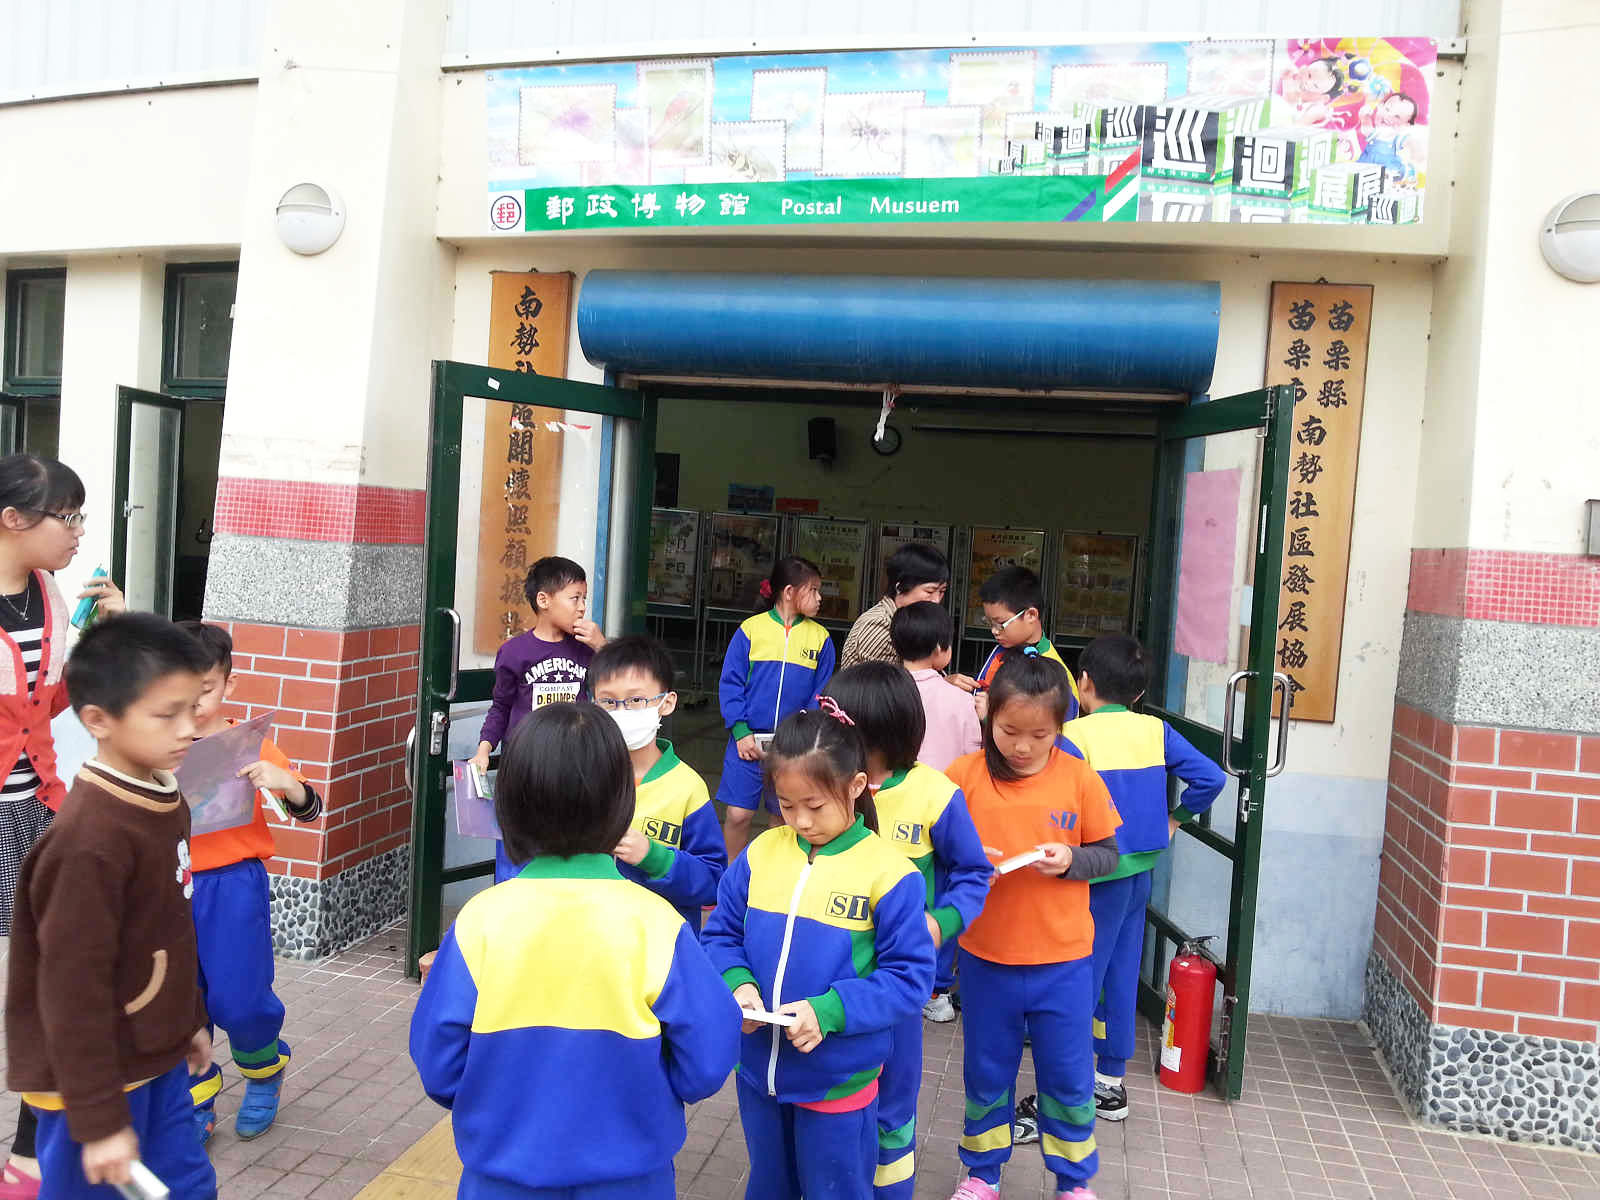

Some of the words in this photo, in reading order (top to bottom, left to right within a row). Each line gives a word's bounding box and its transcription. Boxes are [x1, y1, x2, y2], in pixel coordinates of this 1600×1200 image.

[545, 192, 750, 226] 郵政博物館
[781, 195, 842, 216] Postal
[869, 195, 961, 214] Musuem
[1317, 299, 1355, 408] 苗栗縣
[524, 657, 587, 685] AMERICAN
